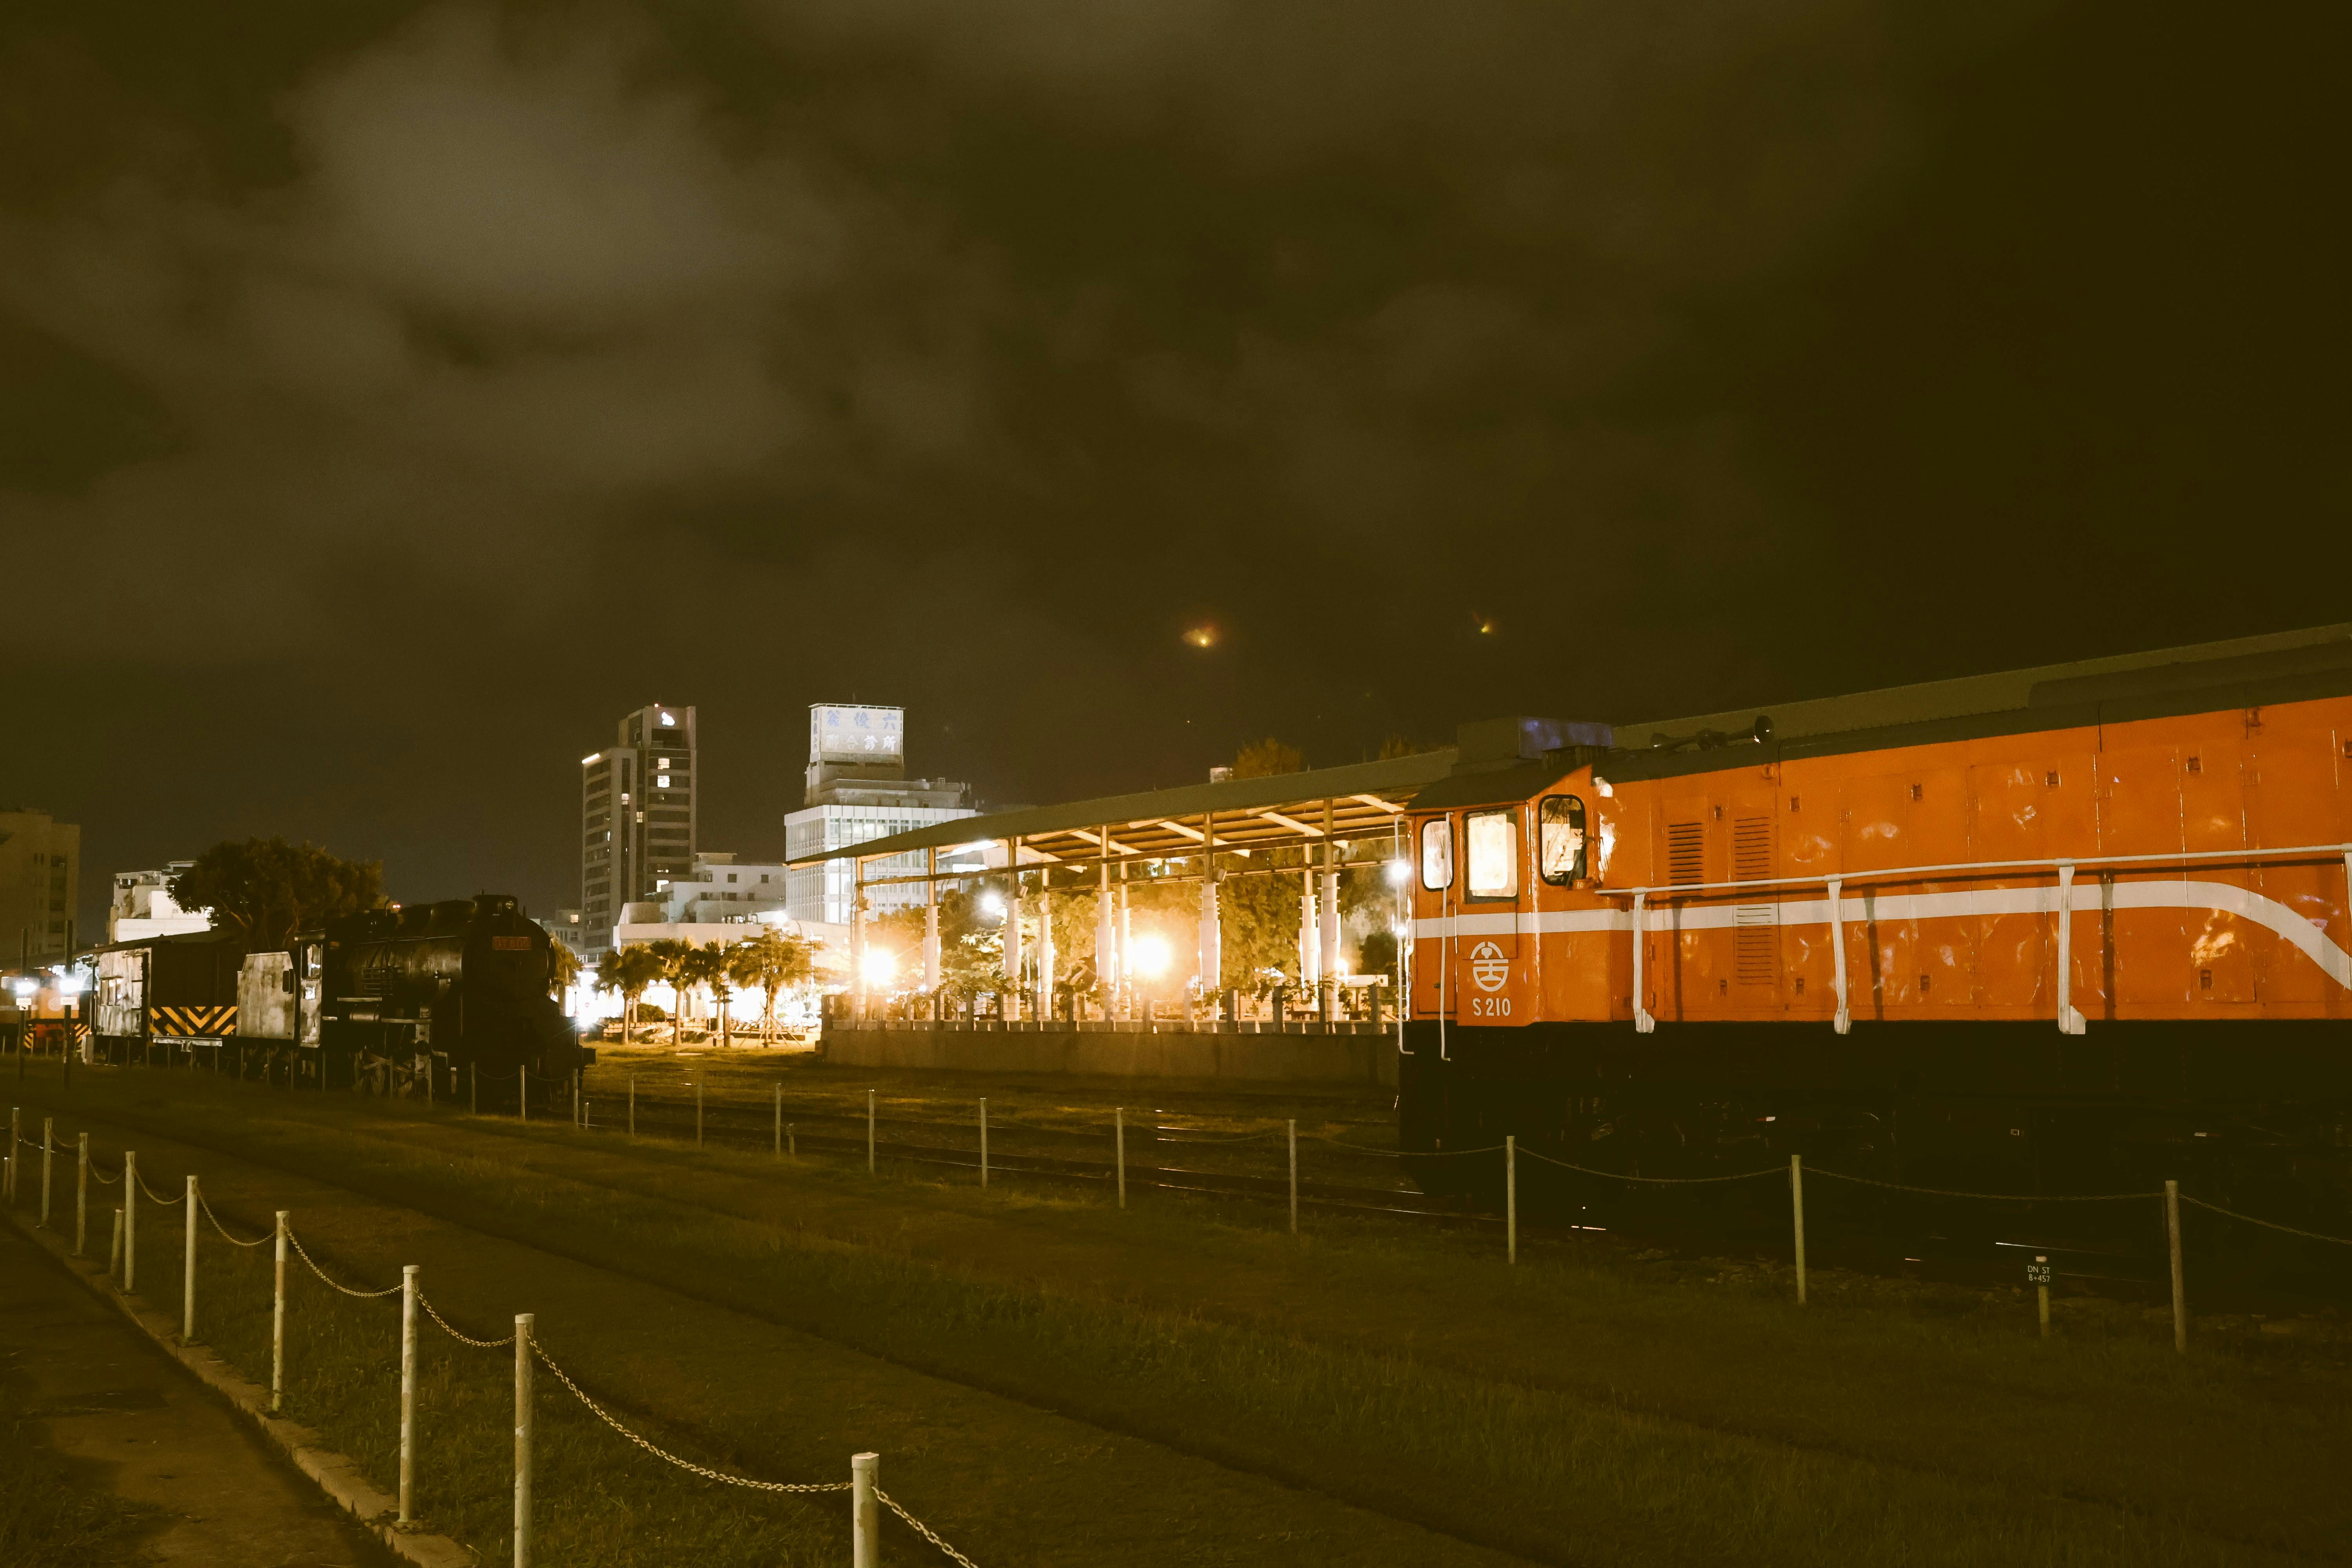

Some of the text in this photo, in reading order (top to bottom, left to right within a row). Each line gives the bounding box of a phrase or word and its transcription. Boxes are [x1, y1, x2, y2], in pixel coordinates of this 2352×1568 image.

[1473, 998, 1511, 1016] S 210
[2029, 1274, 2050, 1282] 8+457
